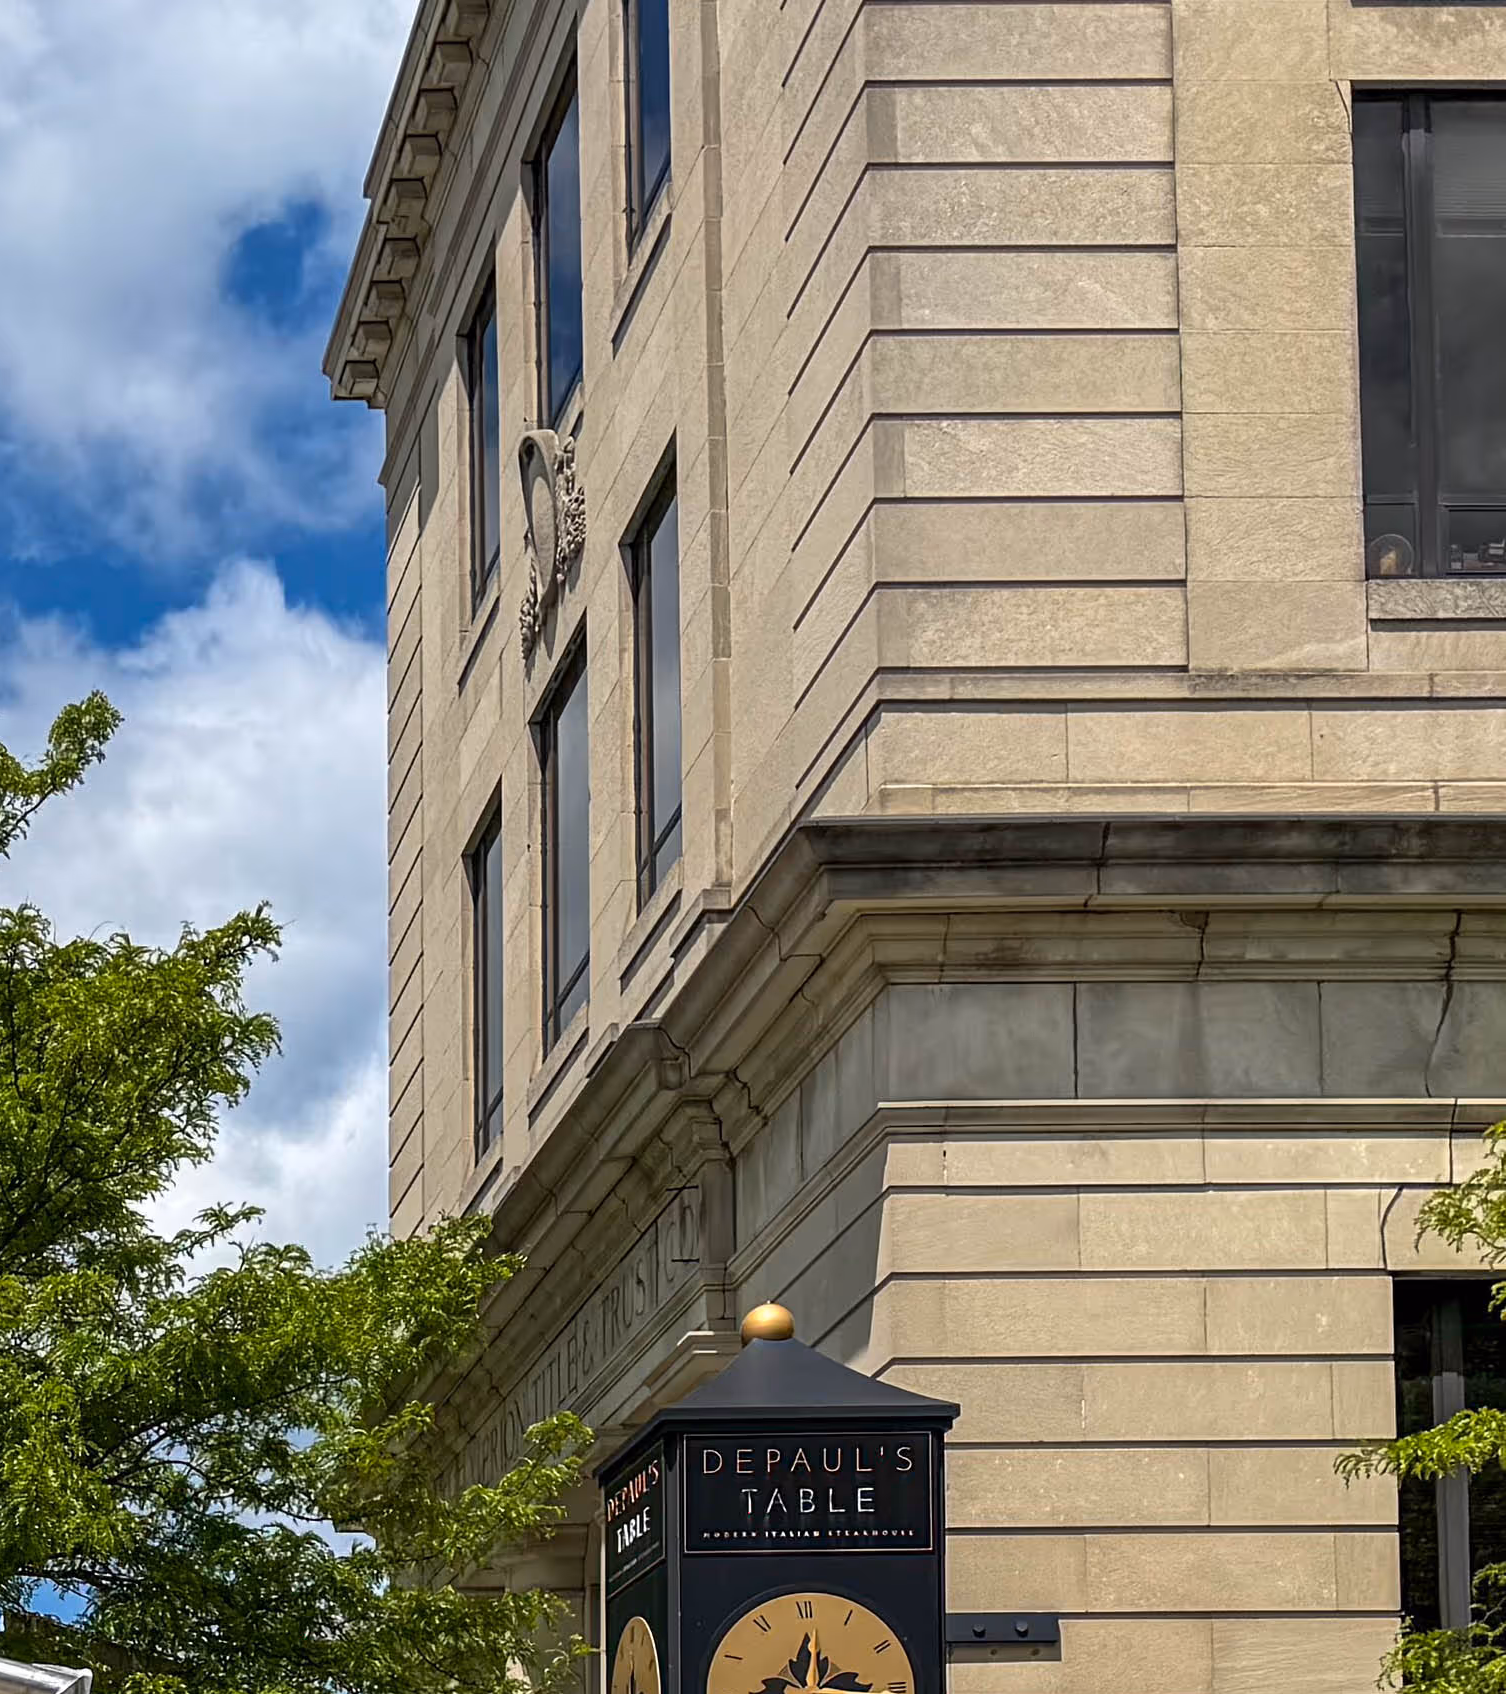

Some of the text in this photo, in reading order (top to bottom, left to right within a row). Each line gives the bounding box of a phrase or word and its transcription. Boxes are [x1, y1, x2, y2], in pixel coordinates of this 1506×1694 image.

[702, 1446, 913, 1474] DEPAUL'S
[741, 1487, 875, 1514] TABLE
[616, 1506, 651, 1554] TABLE
[765, 1530, 820, 1538] ITALIAN
